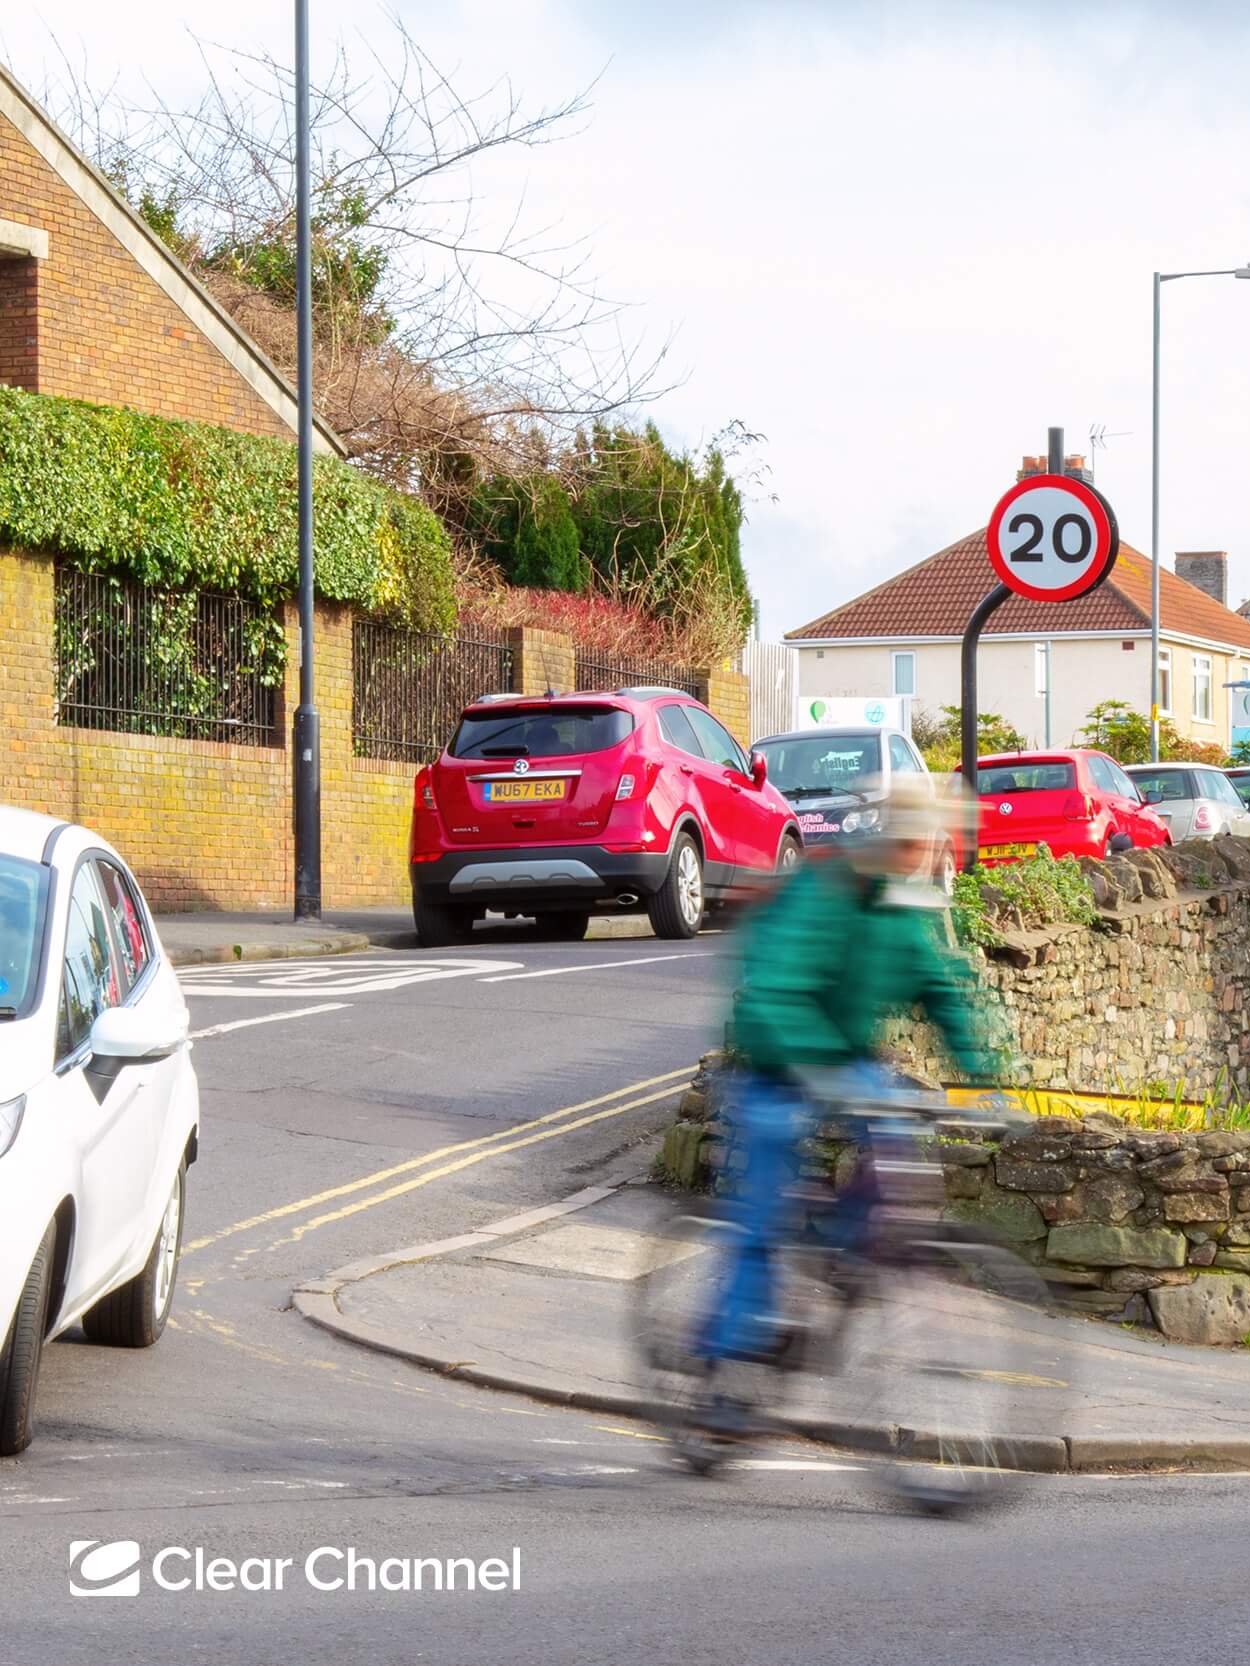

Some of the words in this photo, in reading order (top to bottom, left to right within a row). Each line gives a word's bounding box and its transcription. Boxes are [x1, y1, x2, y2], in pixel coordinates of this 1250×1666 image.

[1008, 513, 1092, 563] 20
[494, 784, 530, 797] WU67
[534, 783, 562, 796] EKA
